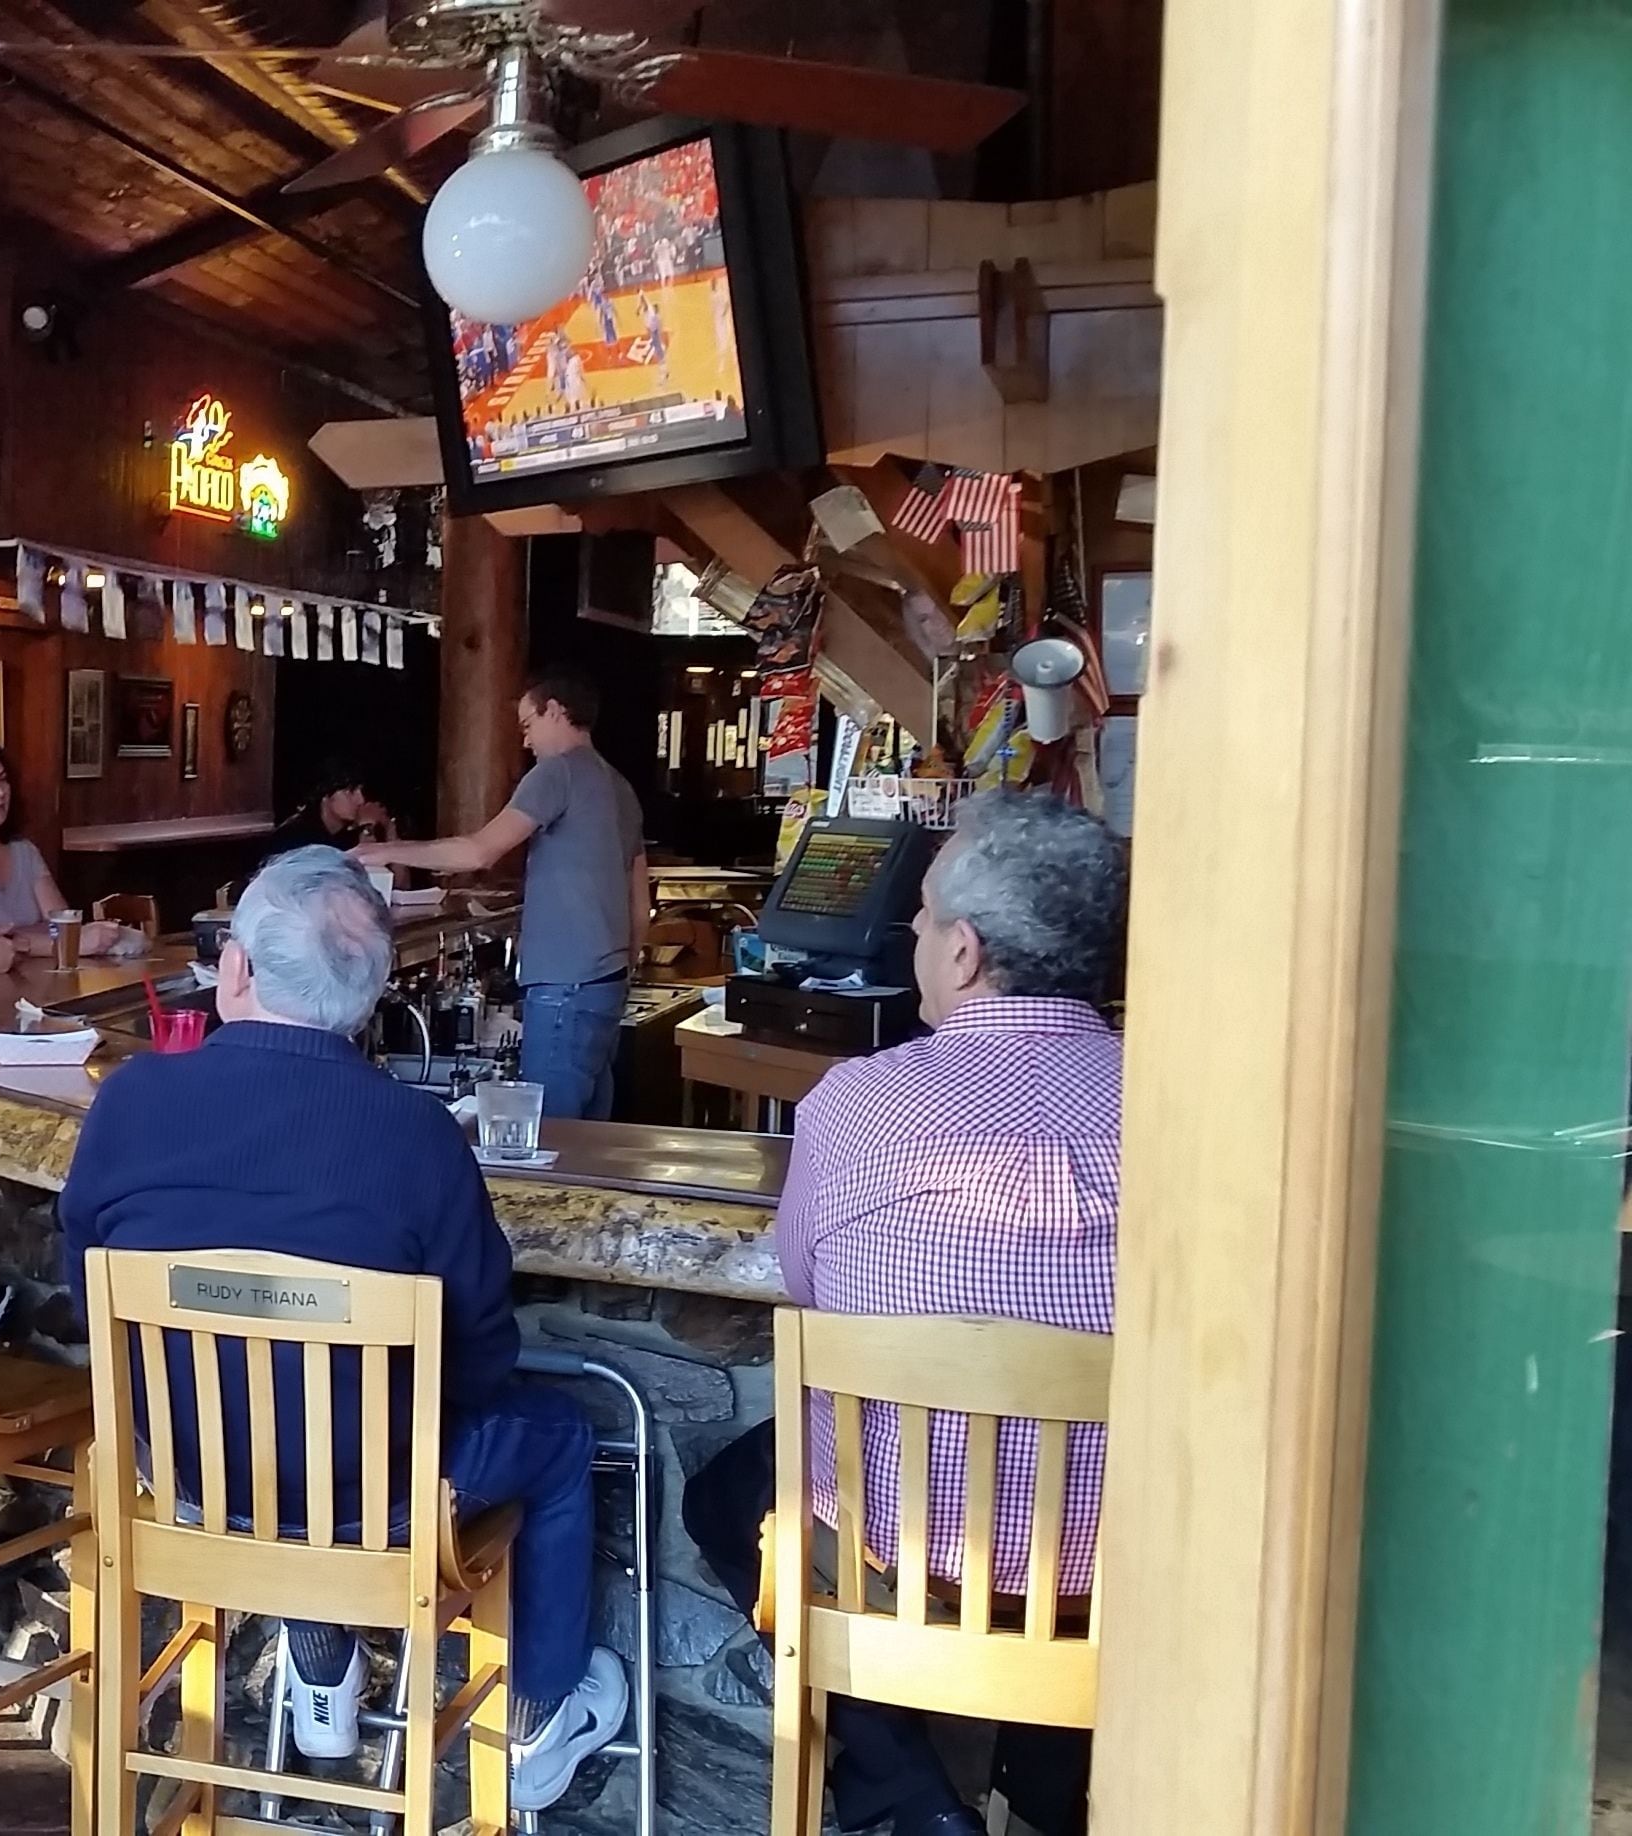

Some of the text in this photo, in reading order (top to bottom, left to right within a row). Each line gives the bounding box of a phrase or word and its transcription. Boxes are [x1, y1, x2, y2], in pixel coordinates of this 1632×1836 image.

[197, 1282, 318, 1307] RUDY TRIANA
[312, 1690, 330, 1726] NIKE
